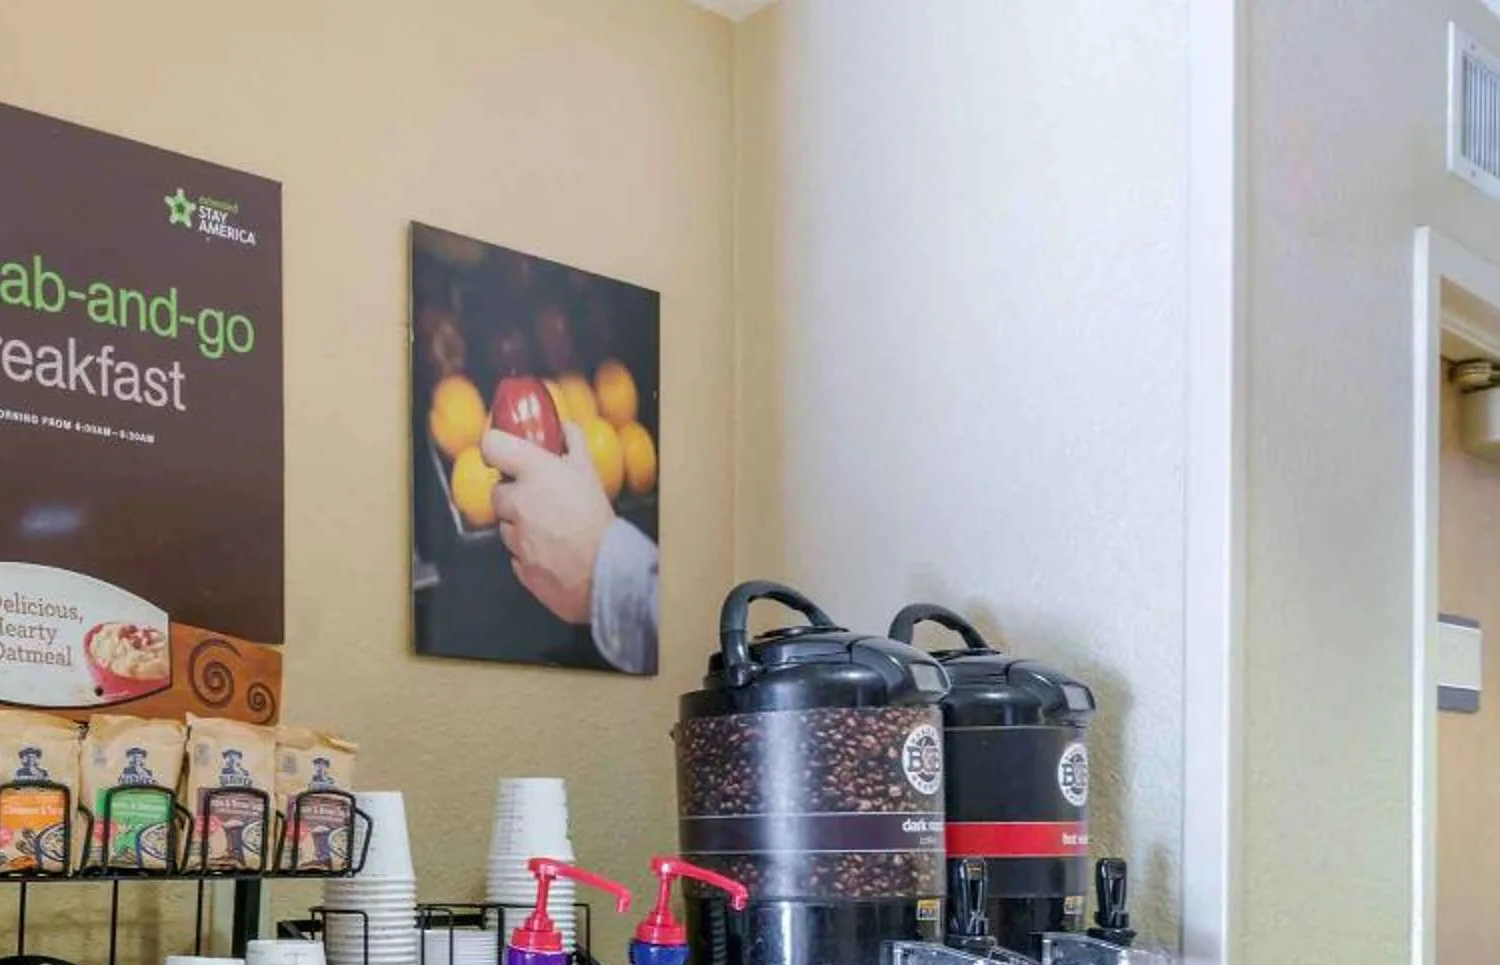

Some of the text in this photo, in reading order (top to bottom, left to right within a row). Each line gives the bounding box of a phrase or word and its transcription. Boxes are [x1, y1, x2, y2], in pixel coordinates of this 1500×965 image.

[198, 206, 229, 222] STAY
[198, 220, 257, 246] AMERICA
[41, 416, 72, 431] FROM
[902, 817, 927, 833] dark
